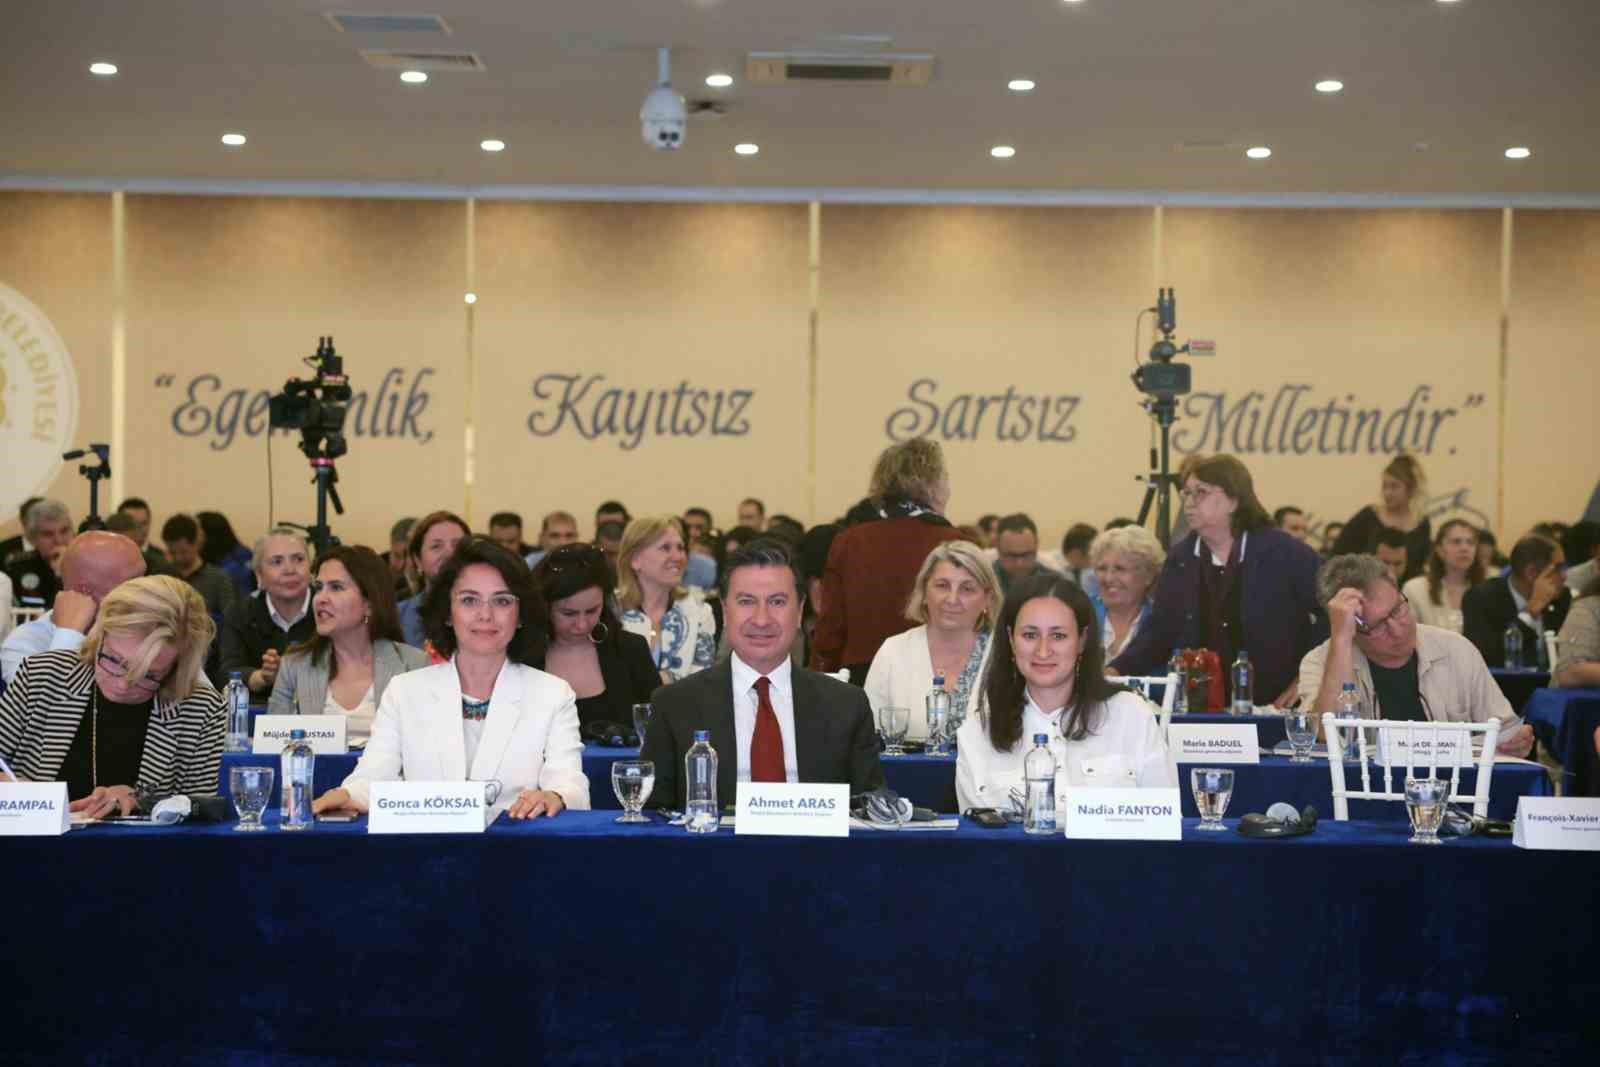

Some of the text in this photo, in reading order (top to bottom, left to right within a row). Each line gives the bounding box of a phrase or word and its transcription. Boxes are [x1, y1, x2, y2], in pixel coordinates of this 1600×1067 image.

[0, 303, 61, 441] ELEDİYESİ
[154, 367, 436, 451] “Egenlik,
[527, 373, 756, 451] Kayıtsız
[1208, 739, 1243, 748] BADUEL
[1421, 740, 1457, 748] DEMAN
[0, 799, 56, 811] RAMPAL
[377, 795, 481, 809] Gonca KÖKSAL
[748, 797, 836, 809] Ahmet ARAS
[1077, 804, 1173, 816] Nadia FANTON
